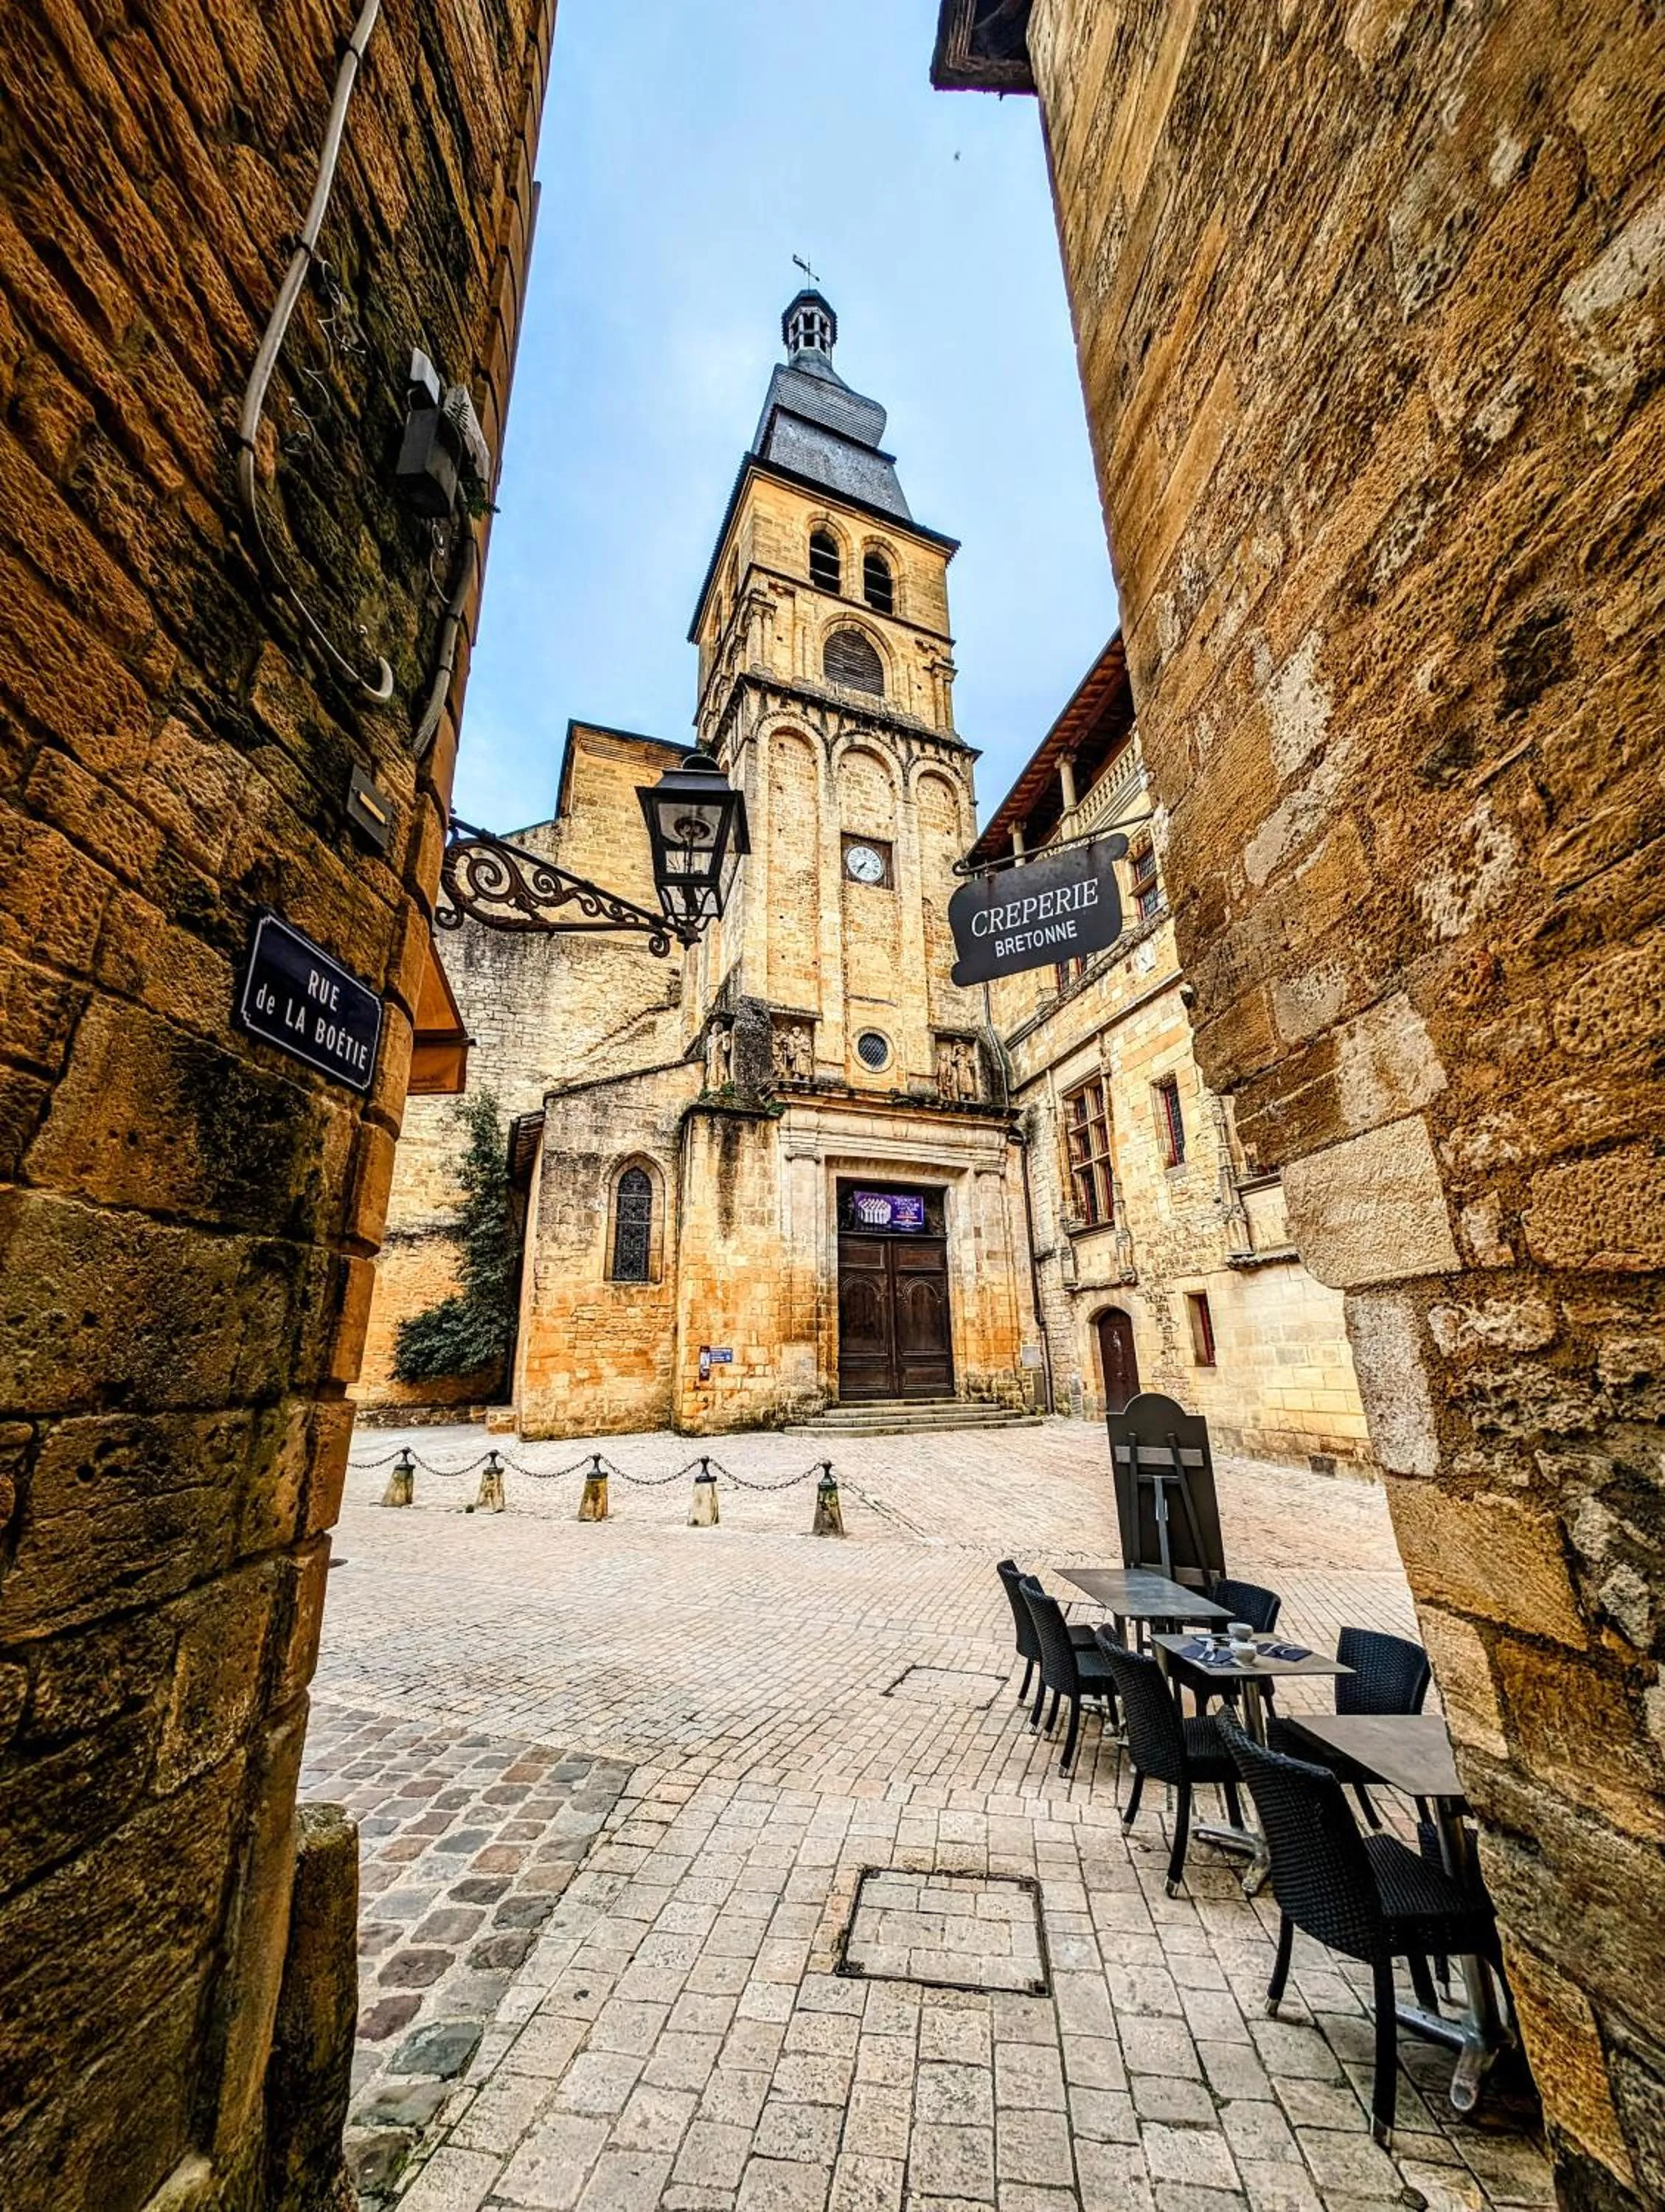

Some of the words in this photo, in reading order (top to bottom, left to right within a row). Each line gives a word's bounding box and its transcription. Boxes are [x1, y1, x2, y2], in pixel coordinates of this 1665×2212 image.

[971, 878, 1099, 937] CREPERIE
[995, 920, 1077, 957] BRETONNE
[256, 983, 275, 1015] de
[285, 998, 306, 1034] LA
[307, 969, 341, 1012] RUE
